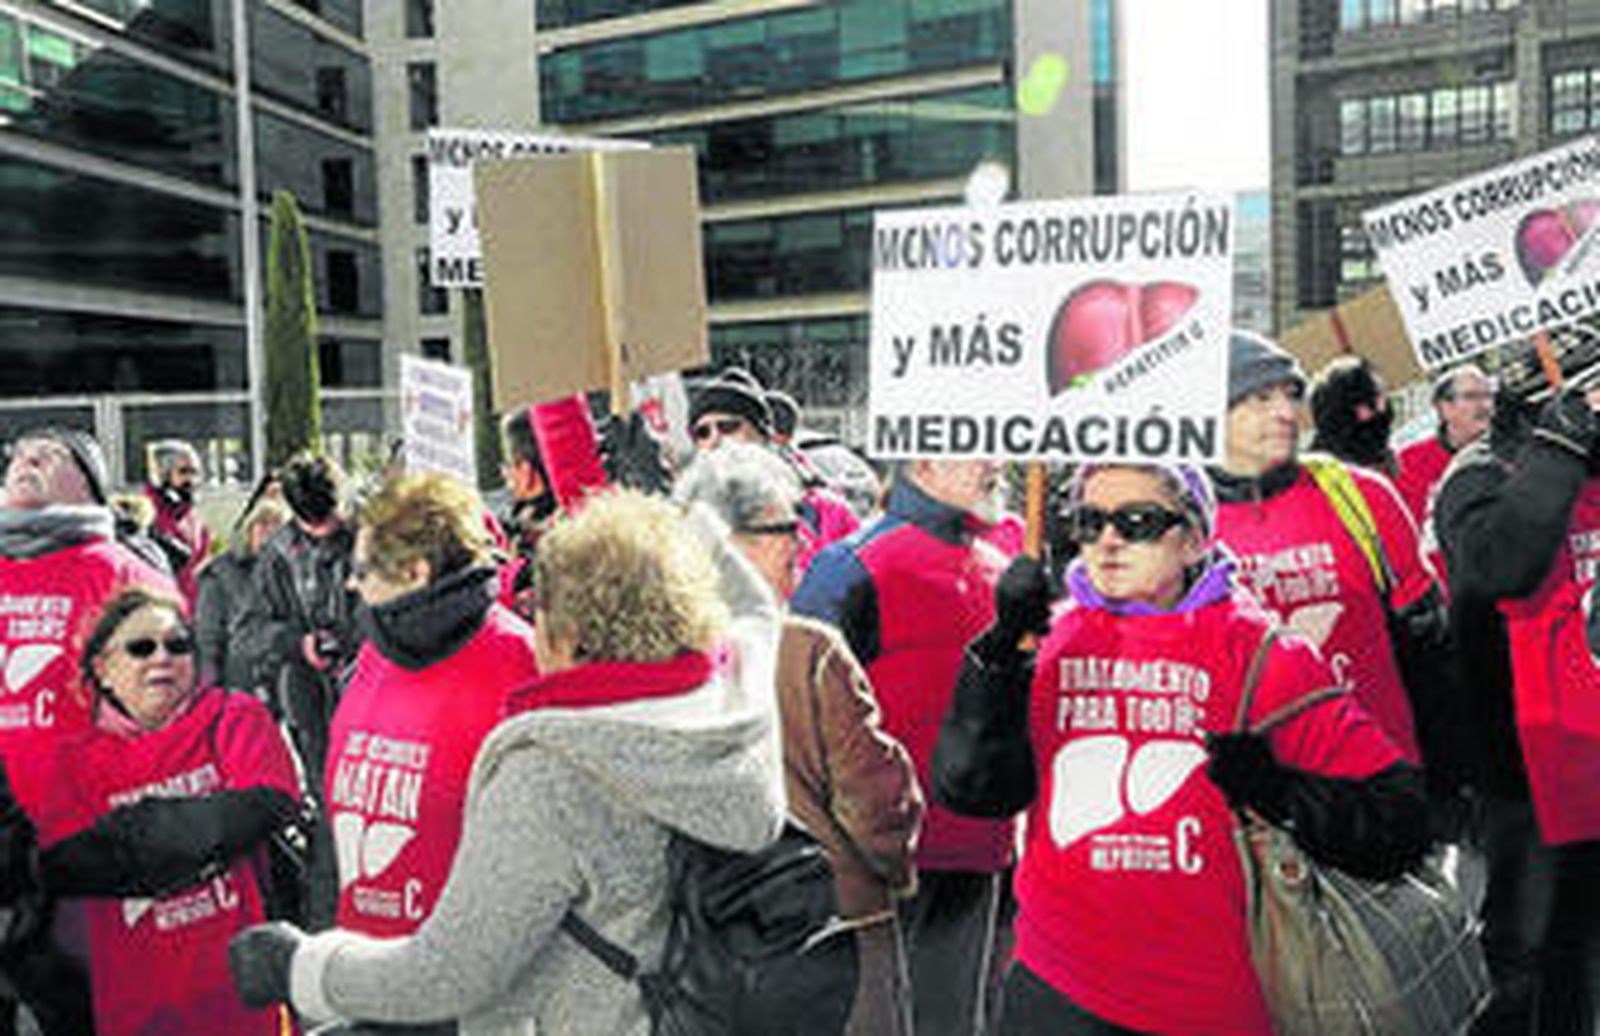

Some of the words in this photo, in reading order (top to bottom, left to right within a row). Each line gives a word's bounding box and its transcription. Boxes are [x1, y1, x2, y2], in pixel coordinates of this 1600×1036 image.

[446, 208, 463, 234] y
[994, 198, 1230, 265] CORRUPCIÓN
[892, 335, 915, 377] y
[929, 313, 1023, 366] MÁS
[874, 405, 1216, 457] MEDICACIÓN
[1177, 817, 1204, 874] C
